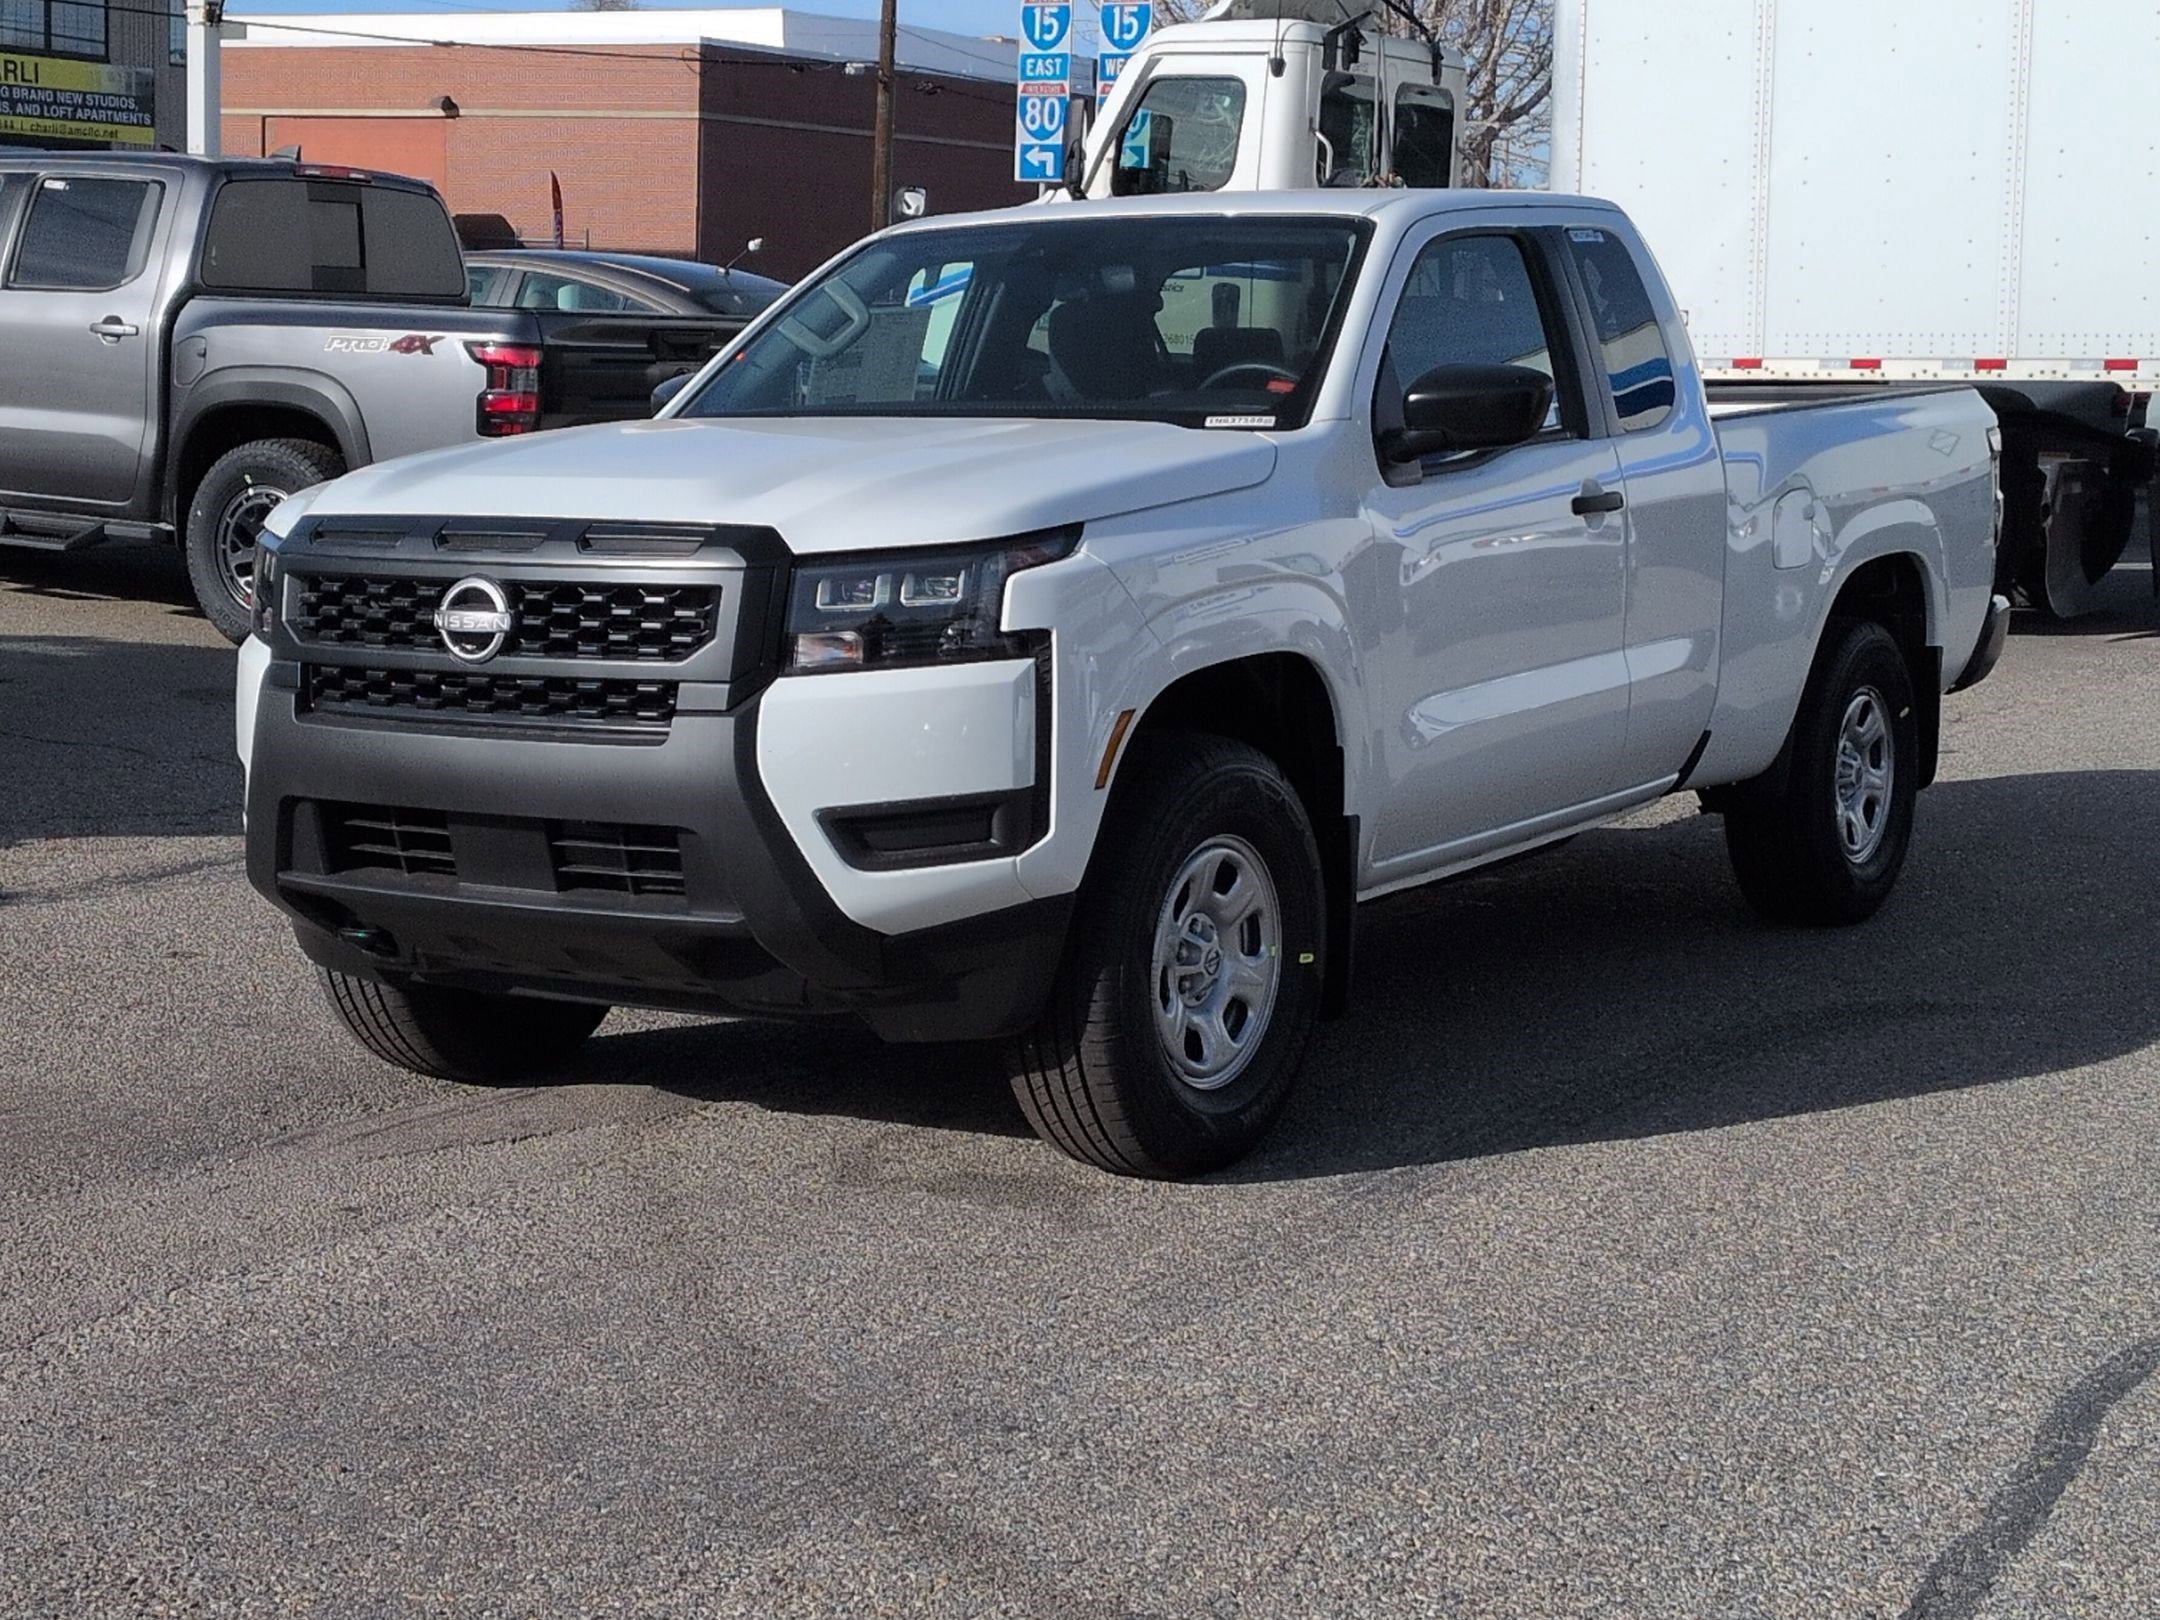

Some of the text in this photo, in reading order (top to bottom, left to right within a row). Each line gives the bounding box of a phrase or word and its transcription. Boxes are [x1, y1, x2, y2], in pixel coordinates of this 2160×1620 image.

[1033, 6, 1059, 41] 15
[1112, 6, 1139, 41] 15
[0, 59, 39, 84] RLI
[1026, 58, 1062, 76] EAST
[13, 87, 53, 102] BRAND
[56, 91, 83, 105] NEW
[86, 94, 139, 111] STUDIOS,
[16, 102, 40, 115] AND
[44, 106, 73, 119] LOFT
[76, 108, 151, 125] APARTMENTS
[1025, 97, 1060, 132] 80
[433, 612, 509, 631] NISSAN
